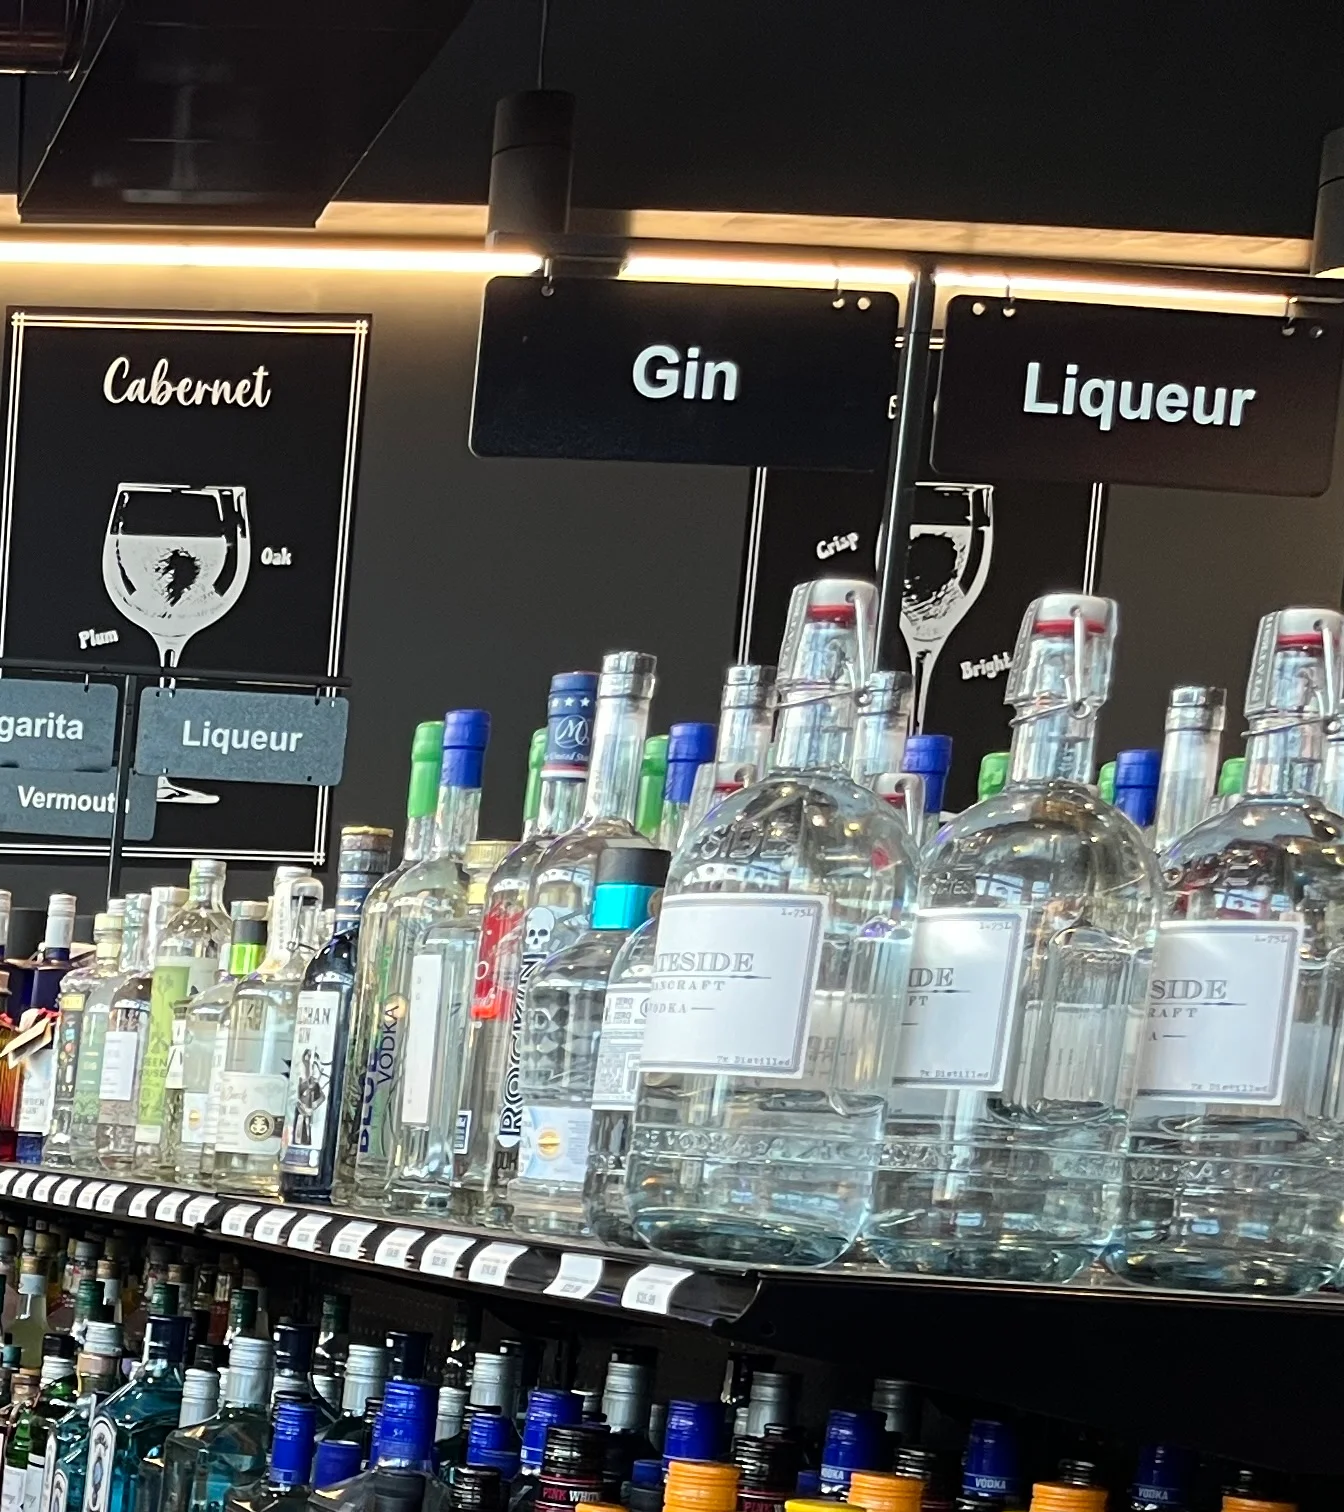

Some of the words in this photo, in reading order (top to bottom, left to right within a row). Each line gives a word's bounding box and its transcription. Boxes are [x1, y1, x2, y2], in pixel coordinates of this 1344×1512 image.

[102, 356, 272, 408] Cabernet
[631, 345, 739, 402] Gin
[1021, 362, 1257, 432] Liqueur
[260, 545, 292, 568] Oak
[816, 531, 861, 561] Crisp
[78, 627, 119, 650] Plum
[181, 720, 304, 755] Liqueur
[377, 1004, 401, 1085] VODKA
[974, 1477, 1007, 1490] VODKA
